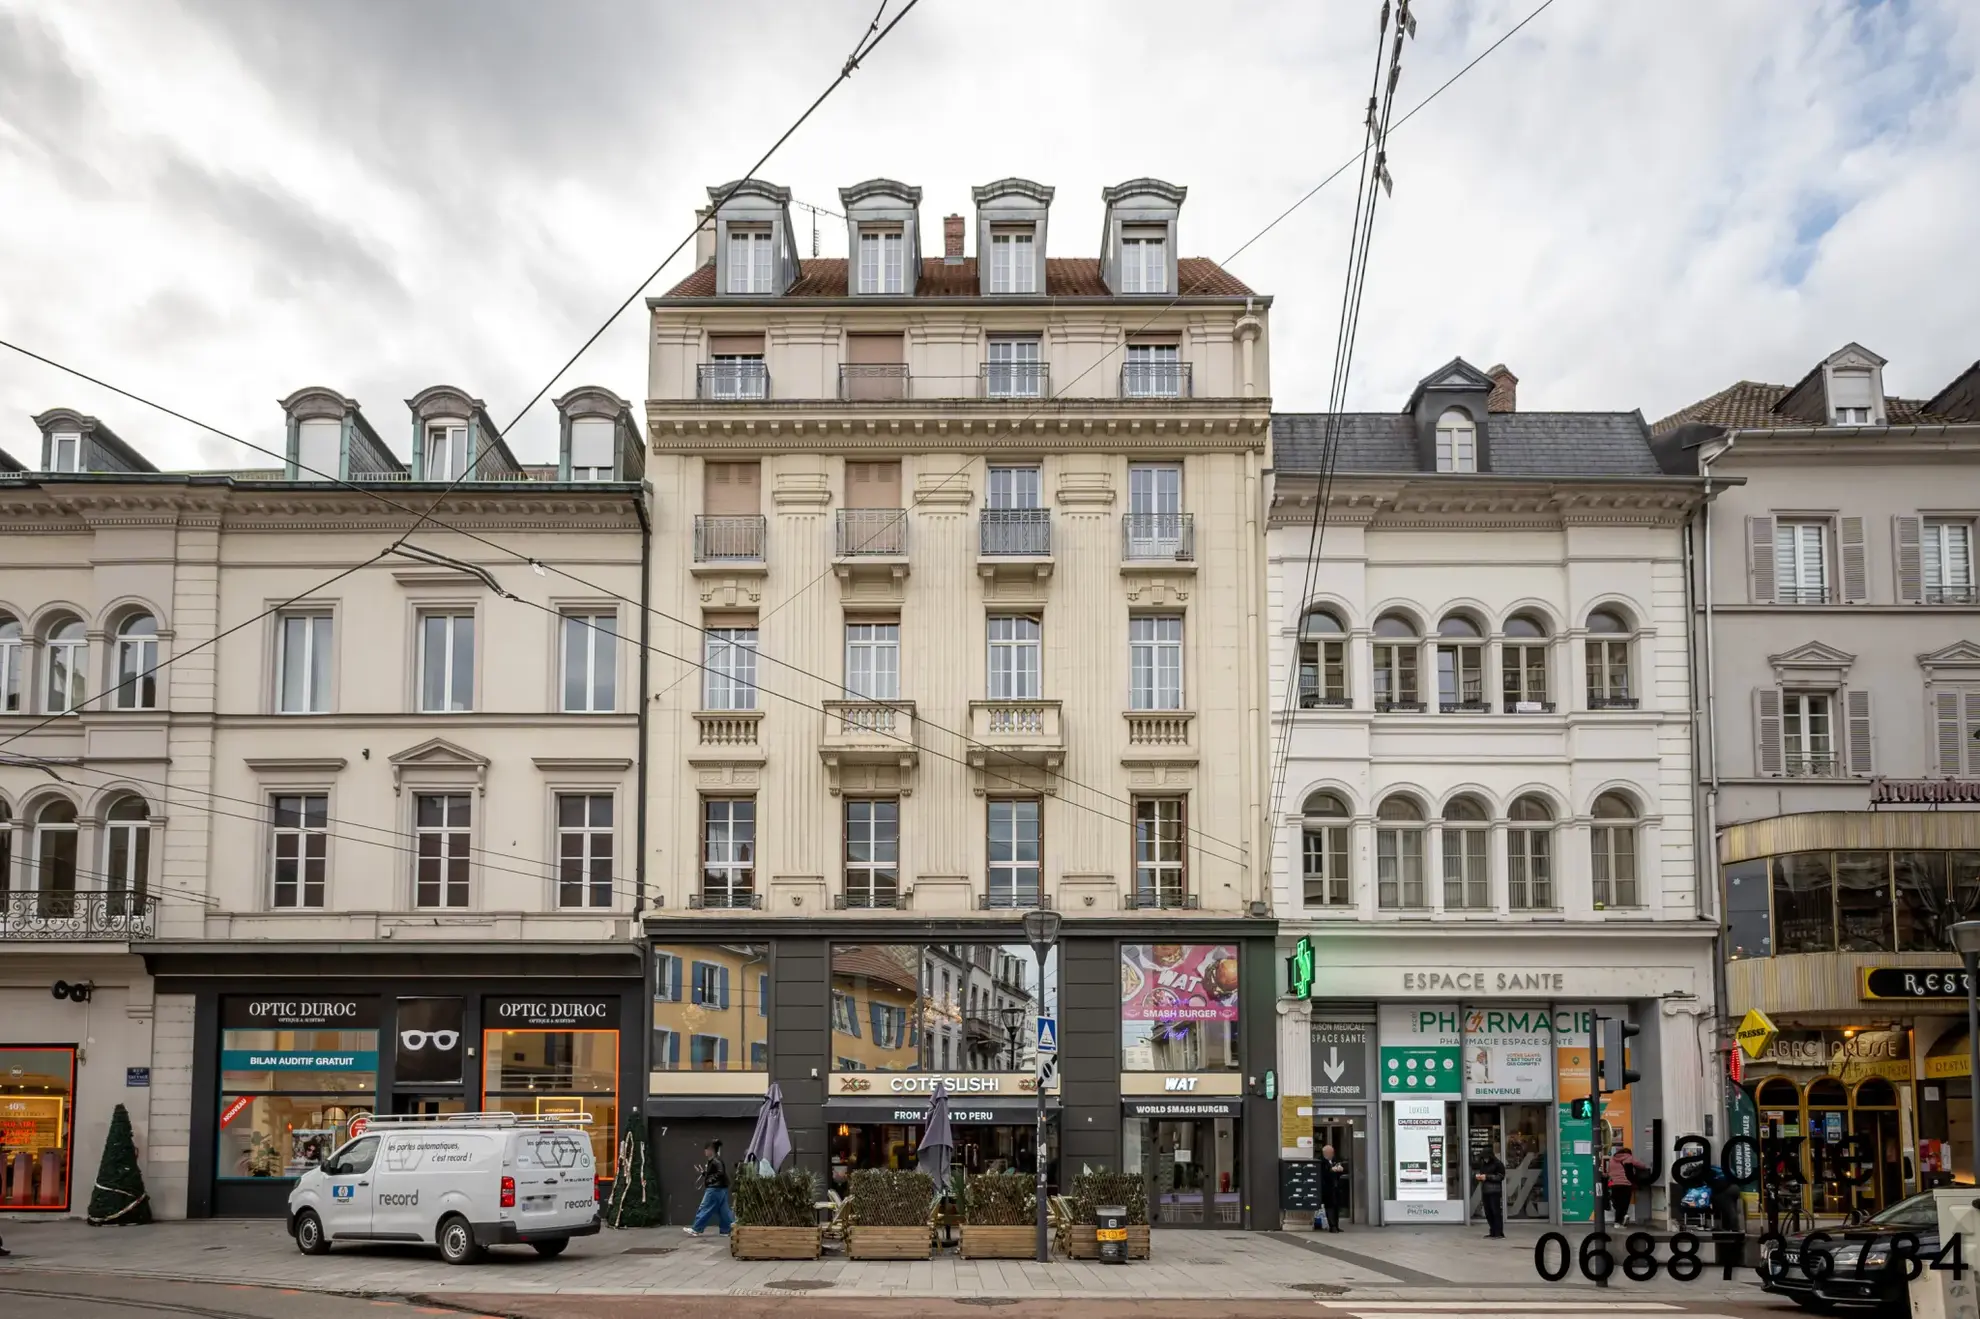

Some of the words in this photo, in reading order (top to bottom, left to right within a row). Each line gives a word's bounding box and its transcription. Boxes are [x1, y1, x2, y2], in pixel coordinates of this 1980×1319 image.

[1157, 969, 1202, 993] WAT
[1403, 973, 1485, 990] ESPACE
[1496, 973, 1564, 990] SANTE
[249, 1002, 296, 1016] OPTIC
[300, 1002, 357, 1016] DUROC
[500, 1003, 546, 1017] OPTIC
[550, 1003, 606, 1017] DUROC
[1143, 1010, 1177, 1018] SMASH
[1179, 1010, 1217, 1018] BURGER
[1419, 1011, 1591, 1034] PHARMACIE
[1311, 1034, 1338, 1043] SPACE
[1340, 1034, 1366, 1043] SANTE
[1738, 1027, 1766, 1039] PRESSE
[1502, 1038, 1539, 1046] ESPACE
[1766, 1040, 1817, 1057] ABAC
[1830, 1040, 1897, 1057] PRESSE
[250, 1057, 276, 1065] BILAN
[278, 1057, 314, 1065] AUDITIF
[315, 1057, 354, 1065] GRATUIT
[944, 1077, 999, 1091] SUSHI
[1165, 1077, 1198, 1091] WAT
[222, 1098, 247, 1122] NOUVEAU
[894, 1111, 920, 1119] FROM
[954, 1112, 967, 1120] TO
[969, 1112, 993, 1120] PERU
[1136, 1105, 1166, 1113] WORLD
[1167, 1105, 1196, 1113] SMASH
[1197, 1105, 1229, 1113] BURGER
[661, 1127, 668, 1136] 7
[388, 1143, 396, 1151] les
[397, 1143, 416, 1153] portes
[417, 1142, 460, 1151] automatiques,
[431, 1153, 446, 1162] c'est
[446, 1152, 468, 1162] record
[379, 1189, 419, 1206] record
[564, 1196, 593, 1210] record
